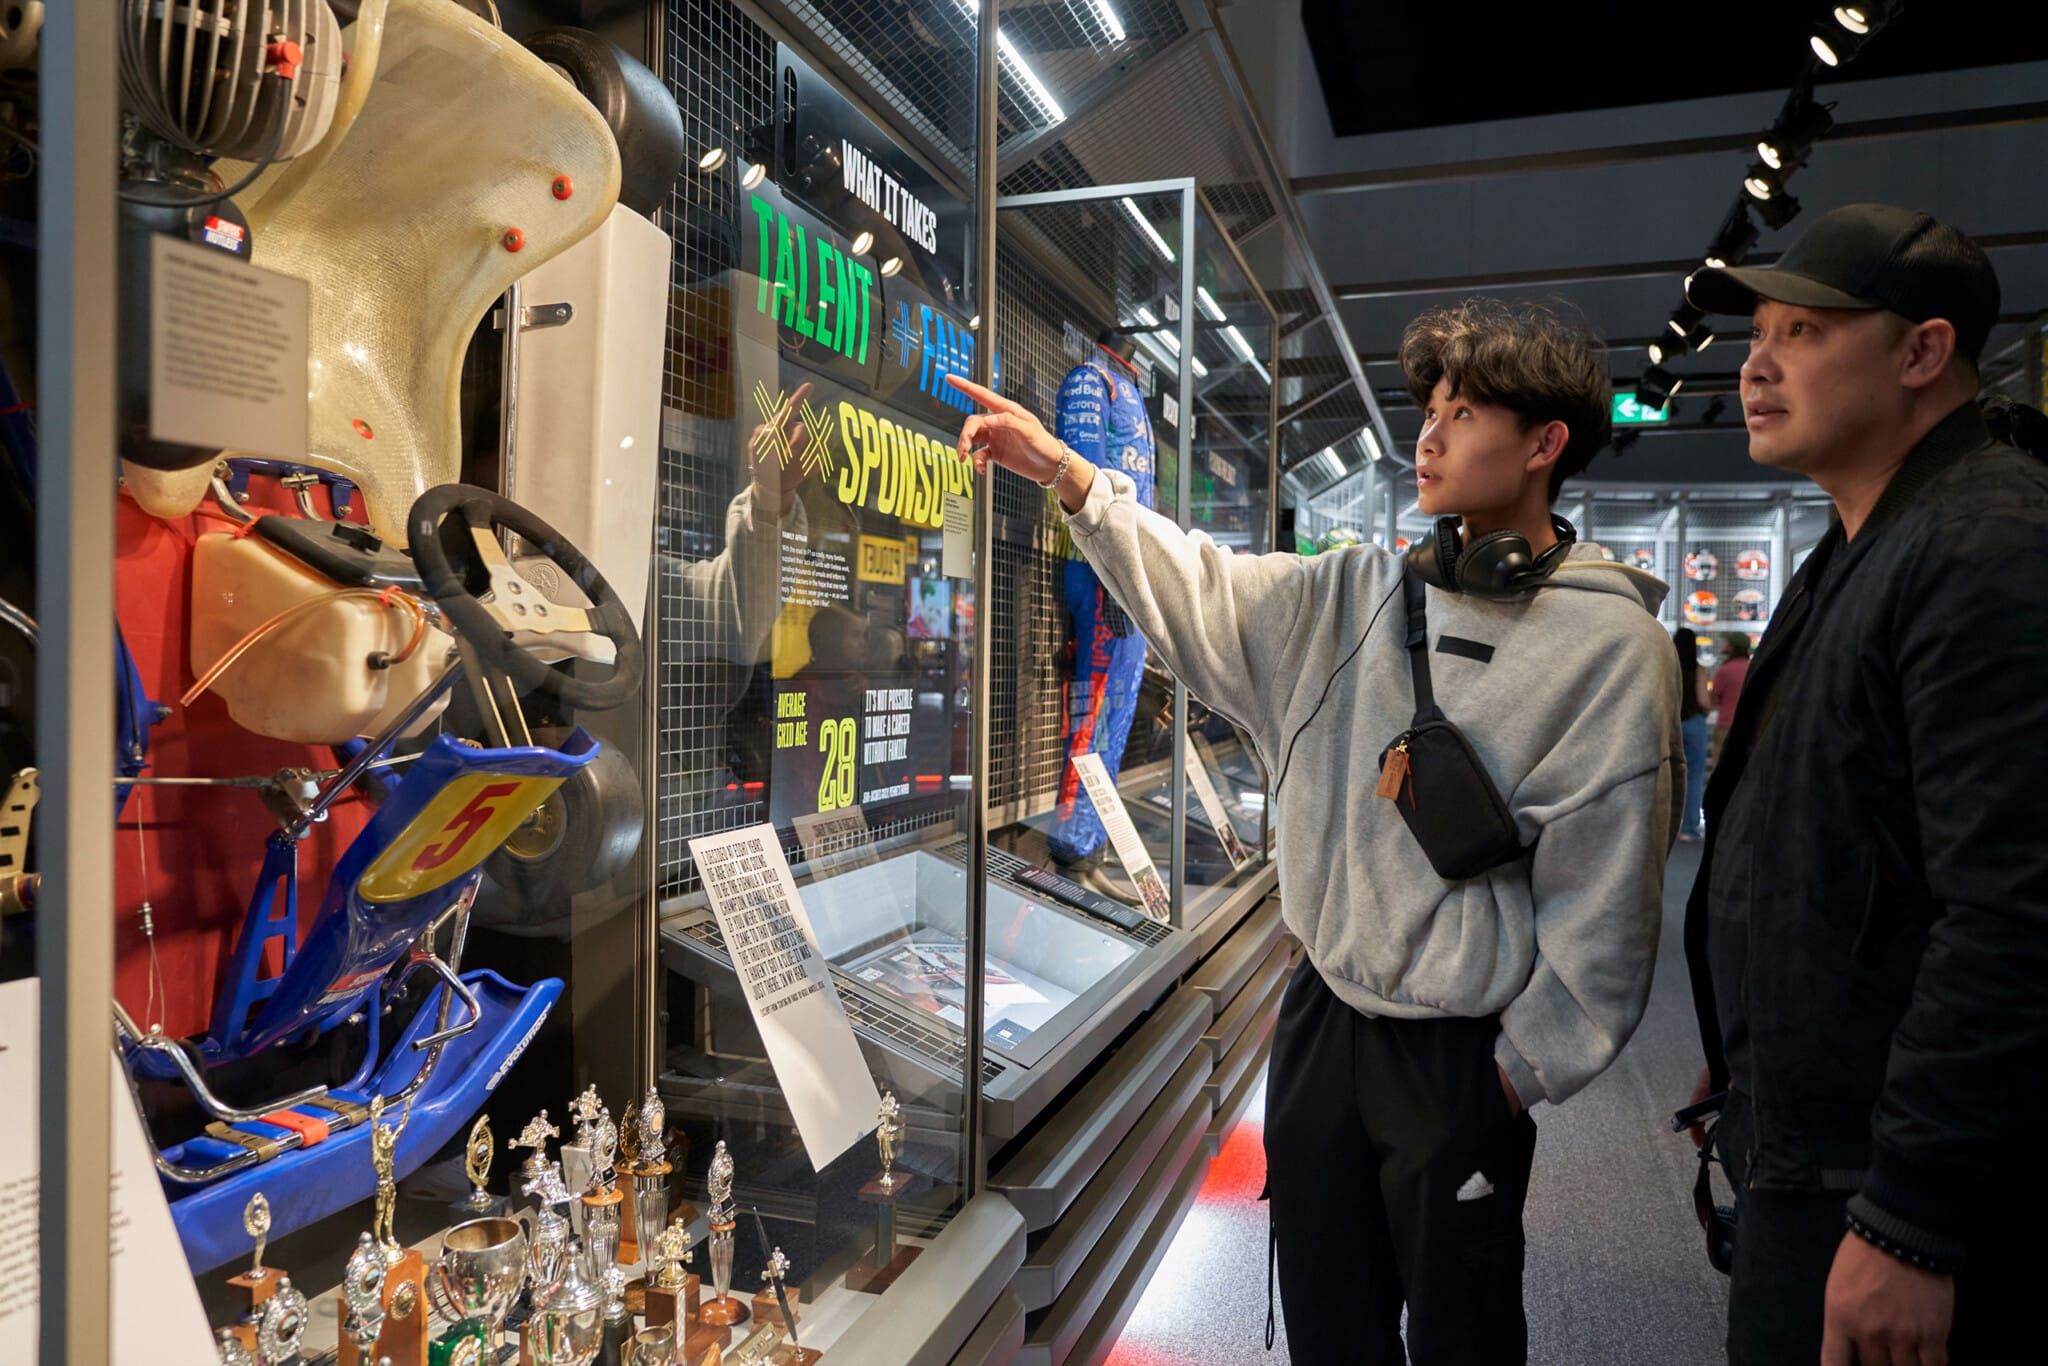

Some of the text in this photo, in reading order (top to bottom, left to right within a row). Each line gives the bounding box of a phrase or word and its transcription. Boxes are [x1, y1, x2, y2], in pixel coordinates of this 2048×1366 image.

[842, 138, 937, 254] WHAT IT TAKES
[751, 195, 873, 365] TALENT
[777, 692, 806, 718] AVERAGE
[777, 721, 808, 749] GRID AGE
[818, 717, 856, 813] 28
[411, 782, 522, 871] 5
